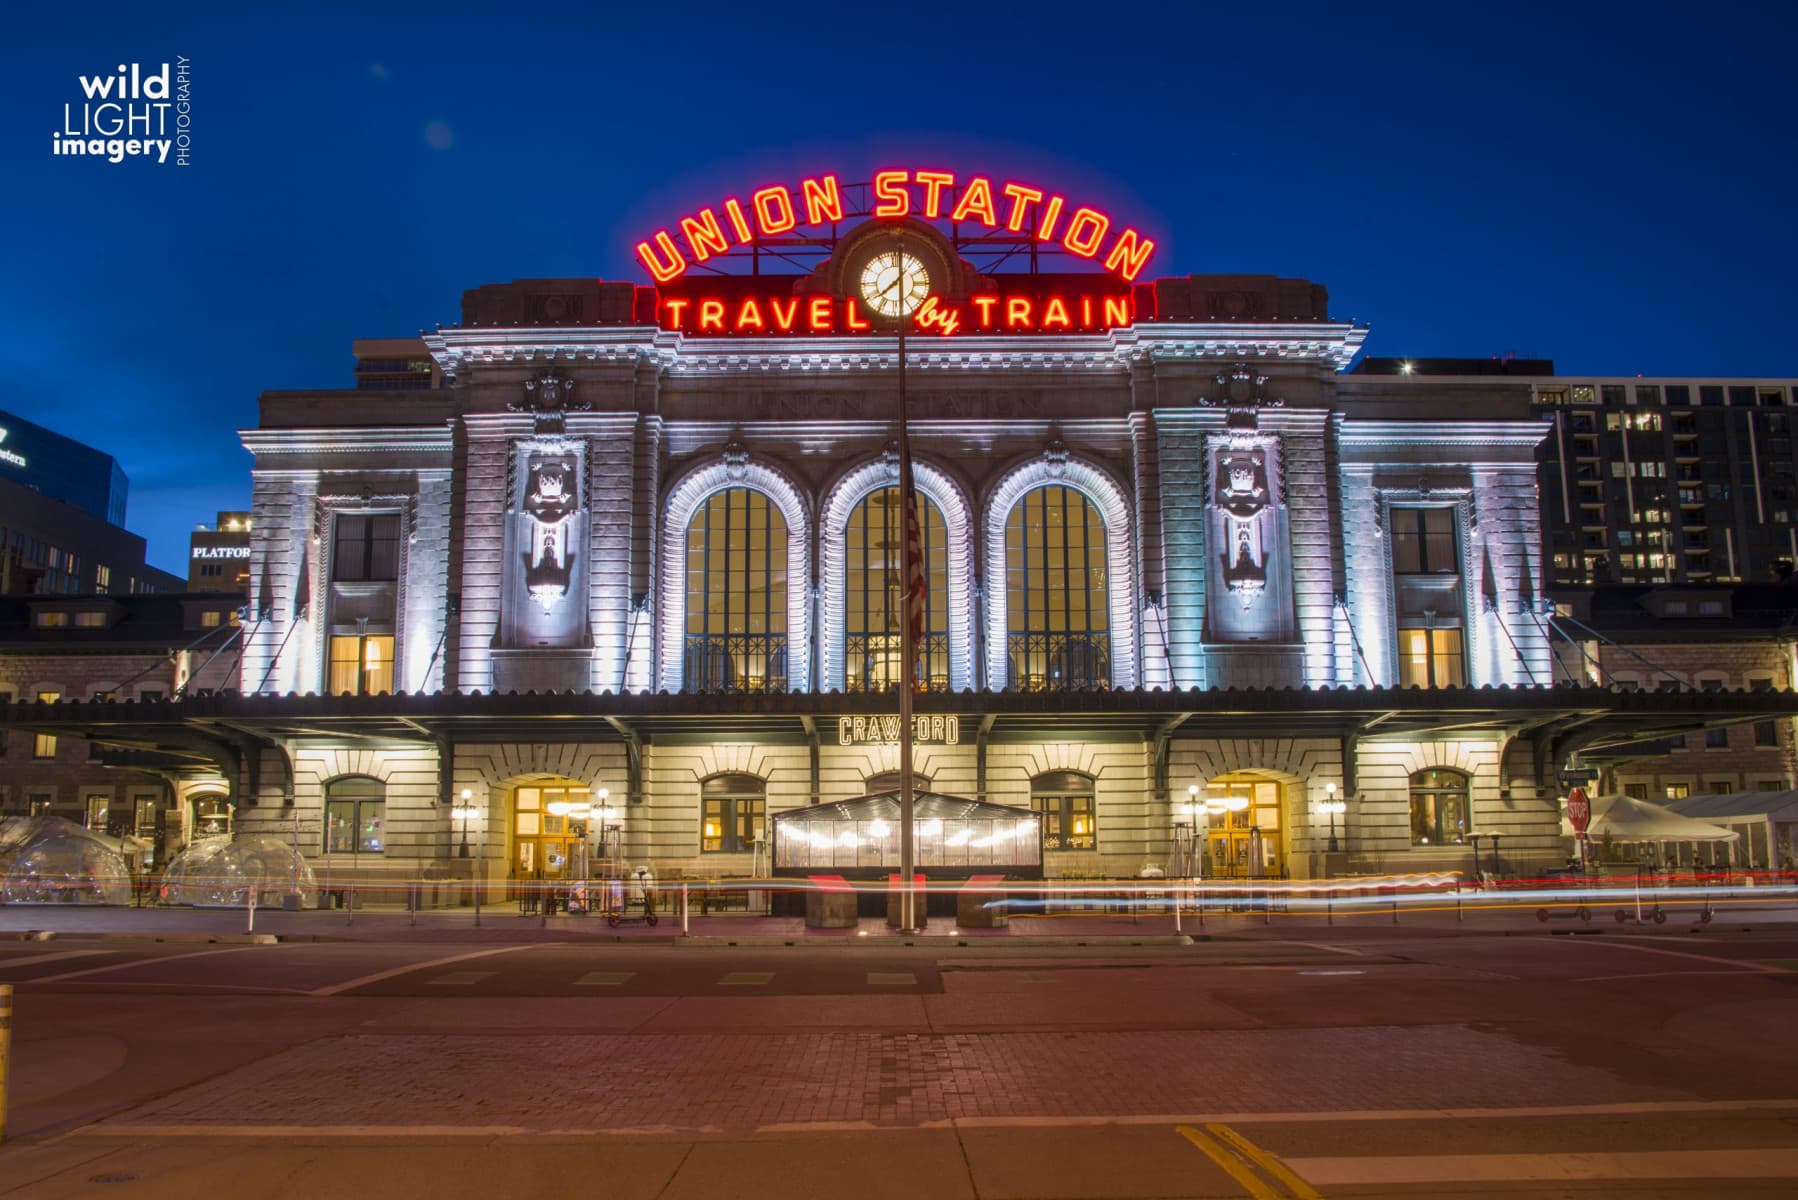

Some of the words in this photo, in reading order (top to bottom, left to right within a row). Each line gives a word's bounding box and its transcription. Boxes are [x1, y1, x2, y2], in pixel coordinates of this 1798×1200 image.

[635, 174, 844, 284] UNION
[874, 169, 1156, 283] STATION
[665, 297, 870, 331] TRAVEL
[914, 295, 959, 337] by
[973, 295, 1131, 330] TRAIN
[1568, 801, 1587, 818] STOP
